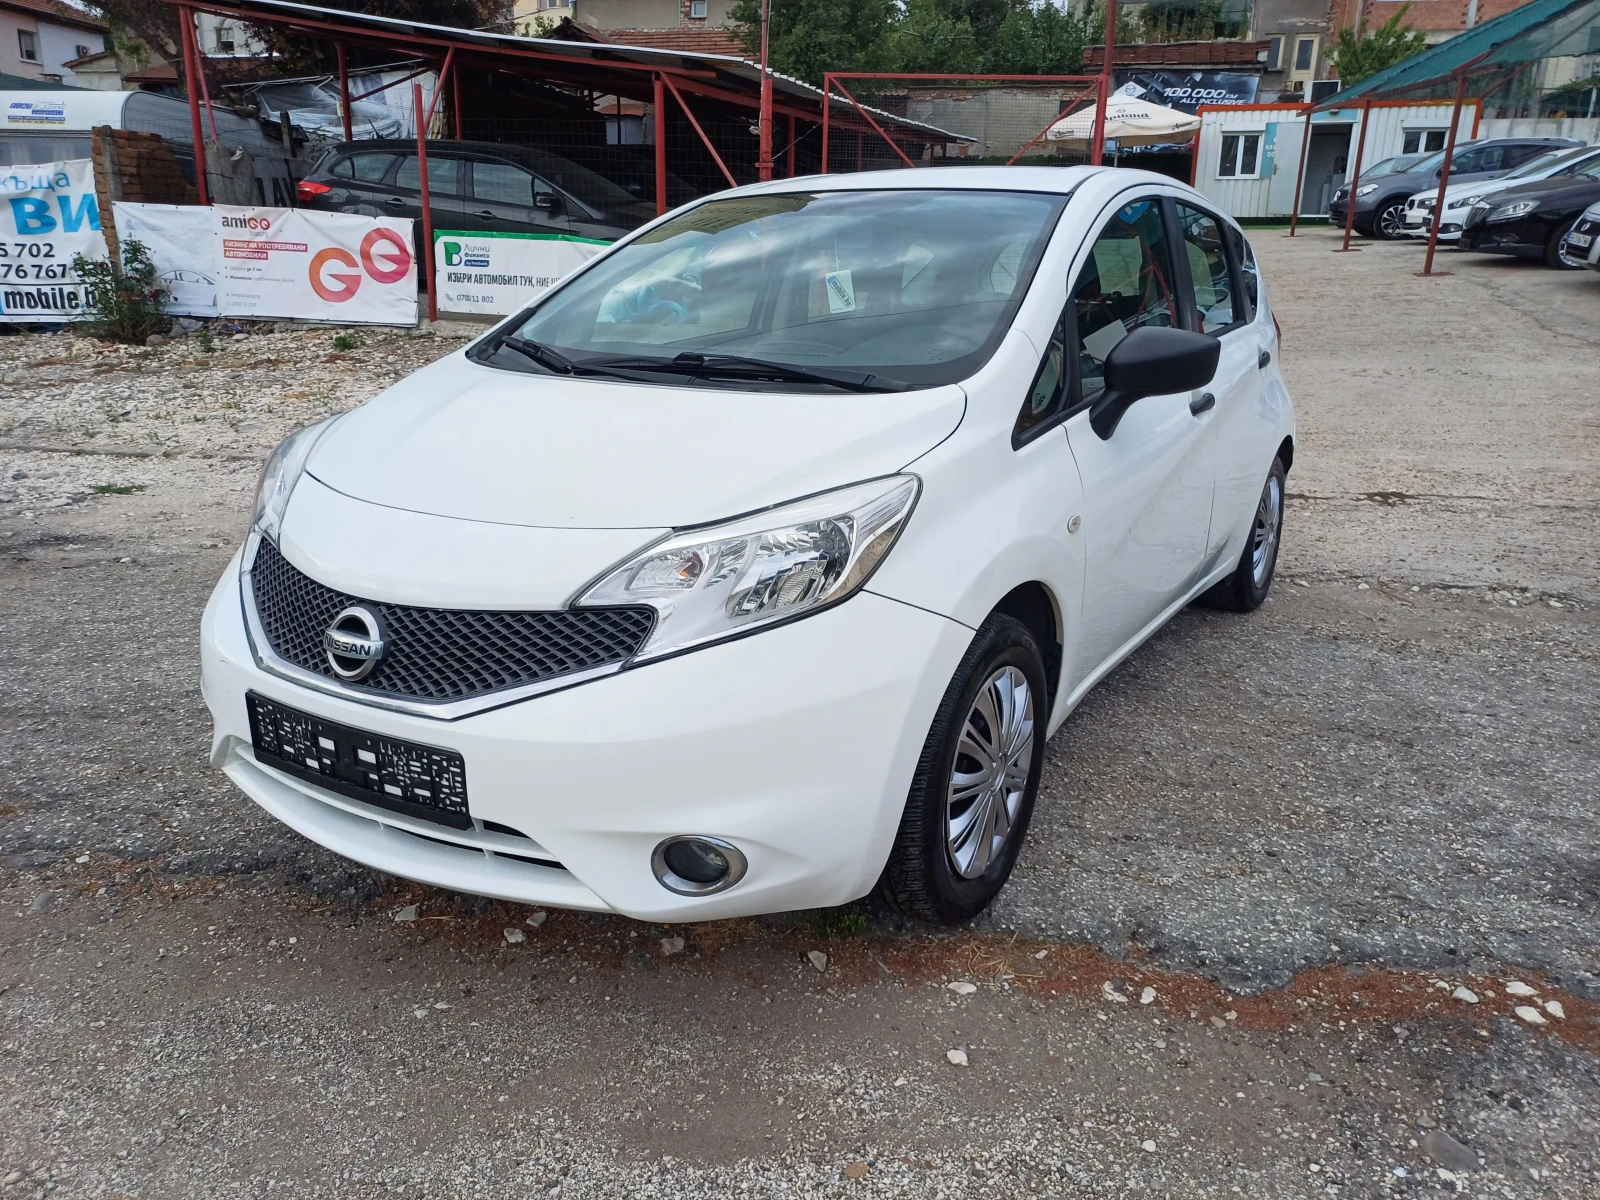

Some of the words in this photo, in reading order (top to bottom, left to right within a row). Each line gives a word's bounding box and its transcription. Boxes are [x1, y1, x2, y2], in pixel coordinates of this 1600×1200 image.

[1164, 88, 1190, 97] 100
[1191, 88, 1226, 98] 000
[14, 243, 56, 258] 702
[258, 242, 307, 251] УПОТРЕБЯВАНИ
[225, 250, 268, 259] АВТОМОБИЛИ
[447, 272, 472, 283] ИЗБЕРИ
[473, 274, 518, 286] АВТОМОБИЛ
[519, 276, 535, 288] ТУК,
[536, 277, 550, 288] НИЕ
[3, 286, 100, 310] mobile.b
[456, 294, 471, 302] 0700
[831, 280, 852, 307] mobile.bg
[324, 632, 371, 657] NISSAN
